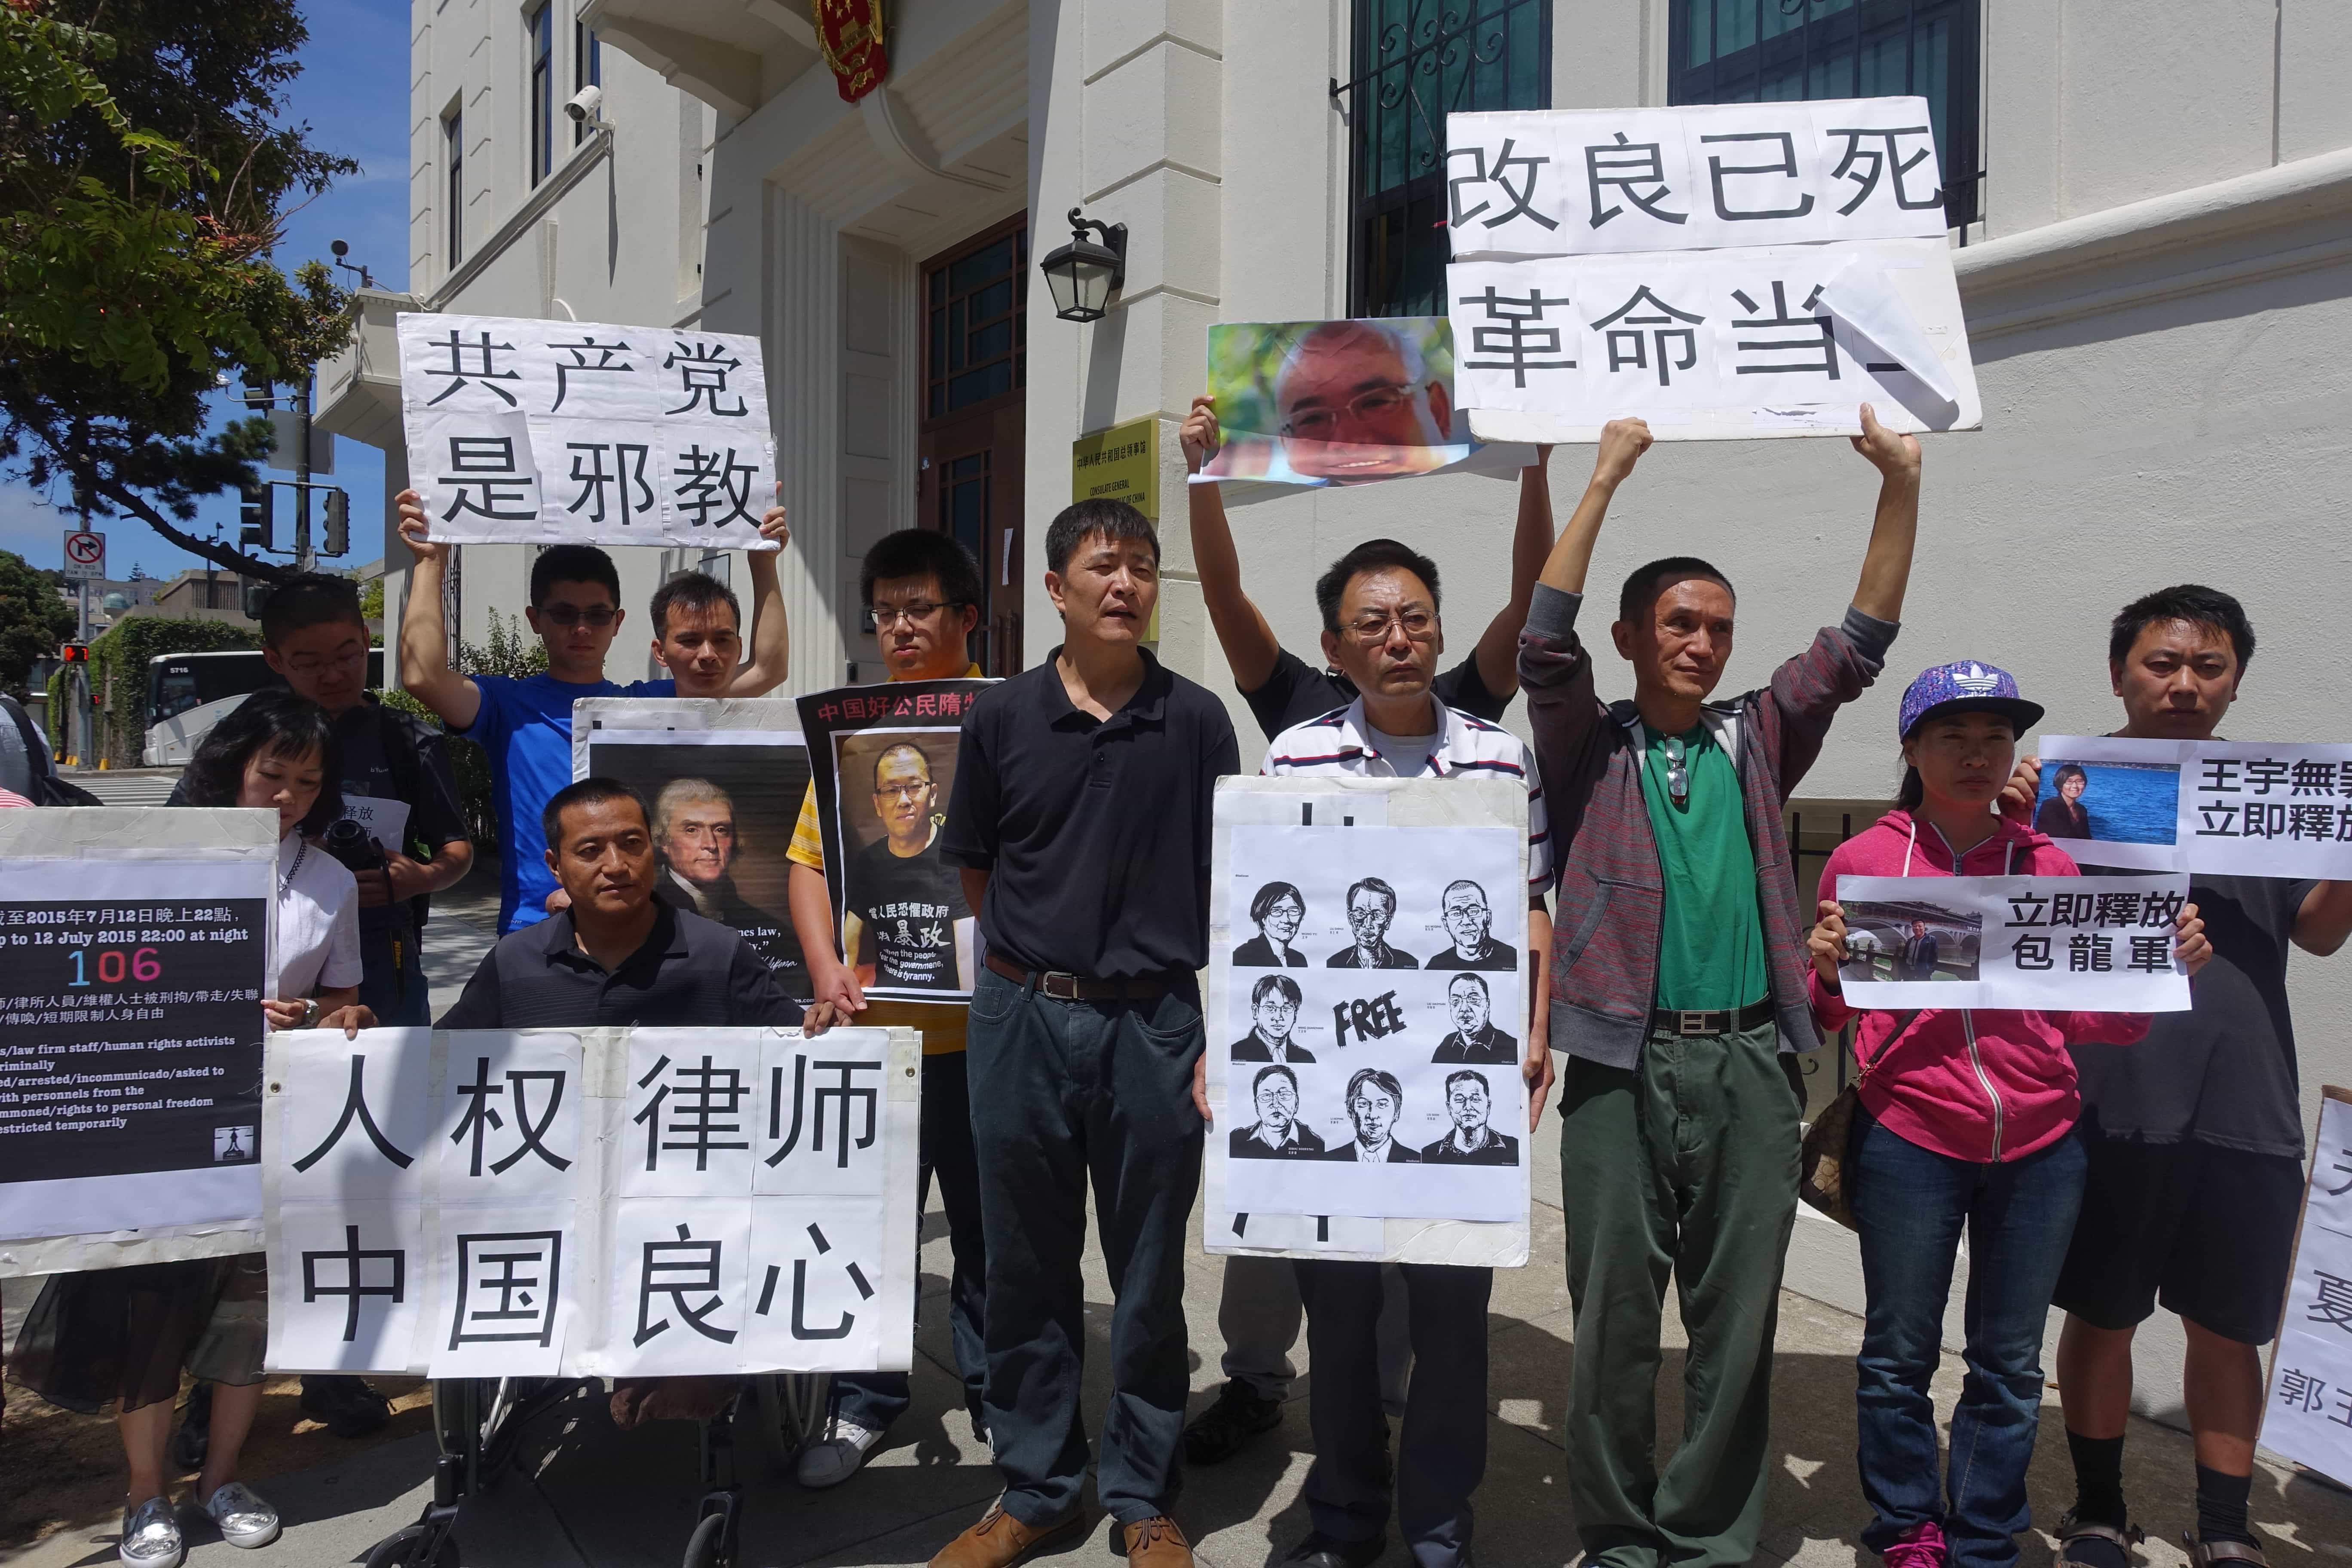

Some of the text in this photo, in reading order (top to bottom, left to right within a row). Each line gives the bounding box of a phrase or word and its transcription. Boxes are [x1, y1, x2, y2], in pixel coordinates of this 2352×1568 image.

[1447, 126, 1943, 231] 改良已死
[1459, 281, 1908, 389] 革命当
[423, 330, 749, 416] 共产党
[1077, 440, 1146, 471] 中华人民共和国总领事馆
[438, 436, 761, 529] 是邪教
[1090, 478, 1130, 496] CONSULATE GENERAL
[1132, 492, 1145, 503] CHINA
[2005, 891, 2185, 929] 立即釋放
[11, 933, 28, 945] to
[34, 932, 54, 945] 12
[58, 931, 94, 946] July
[98, 930, 136, 943] 2015
[141, 929, 186, 943] 22:00
[190, 929, 205, 941] at
[209, 928, 248, 943] night
[757, 926, 781, 938] law,
[889, 956, 898, 965] the
[900, 949, 913, 958] the
[2012, 933, 2171, 974] 包龍軍
[68, 947, 162, 986] 106
[903, 971, 935, 982] tyranny.
[1333, 989, 1408, 1050] FREE
[38, 1044, 66, 1054] firm
[69, 1041, 144, 1053] staff/human
[147, 1038, 183, 1051] rights
[185, 1036, 236, 1047] activists
[212, 1066, 225, 1075] to
[22, 1089, 90, 1104] personnels
[93, 1087, 122, 1098] from
[125, 1086, 144, 1096] the
[96, 1103, 108, 1113] to
[112, 1099, 163, 1114] personal
[166, 1097, 214, 1109] freedom
[55, 1117, 128, 1132] temporarily
[292, 1054, 882, 1177] 人权律师
[303, 1222, 875, 1351] 中国良心
